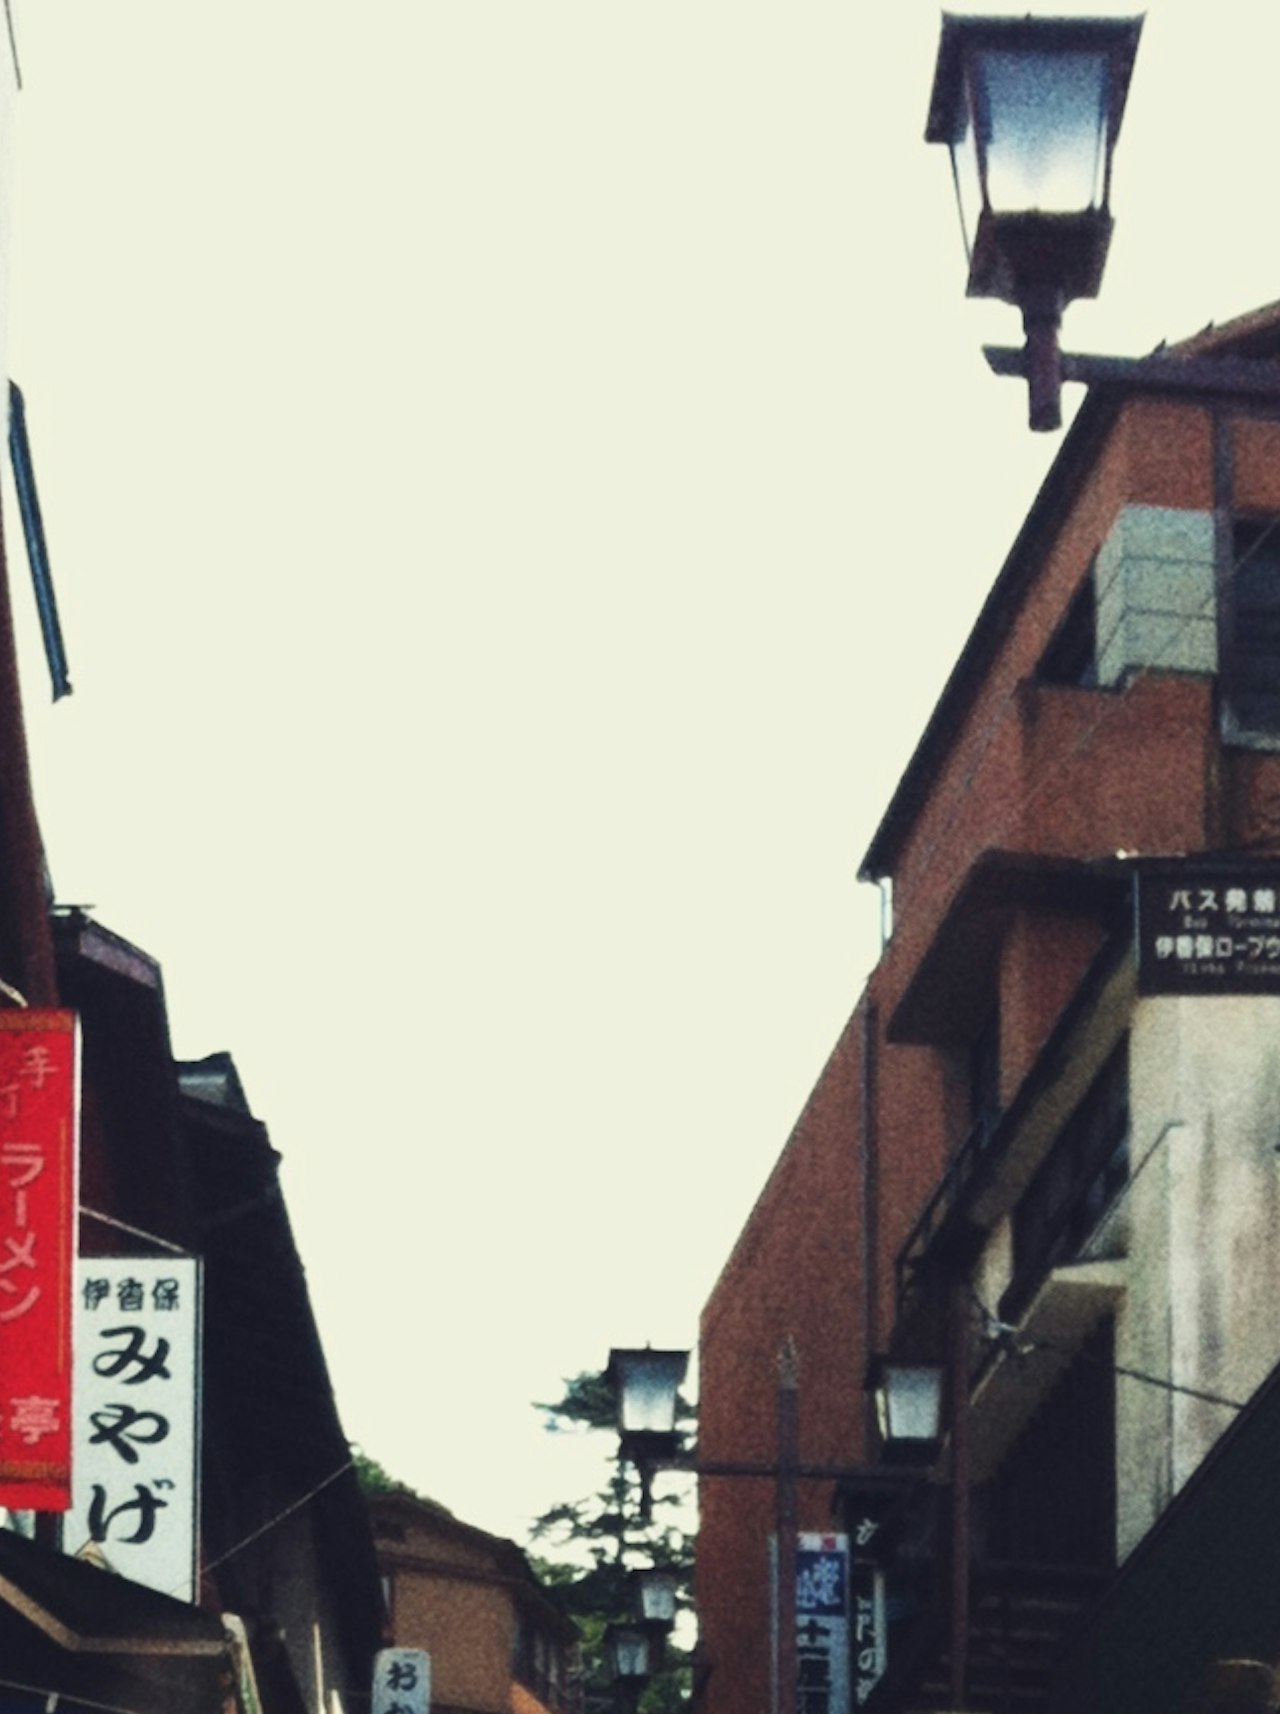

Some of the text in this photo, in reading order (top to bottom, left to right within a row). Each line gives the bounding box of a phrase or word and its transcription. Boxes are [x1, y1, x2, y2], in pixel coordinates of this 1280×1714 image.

[82, 1278, 180, 1312] 伊香保
[88, 1324, 177, 1546] みやげ
